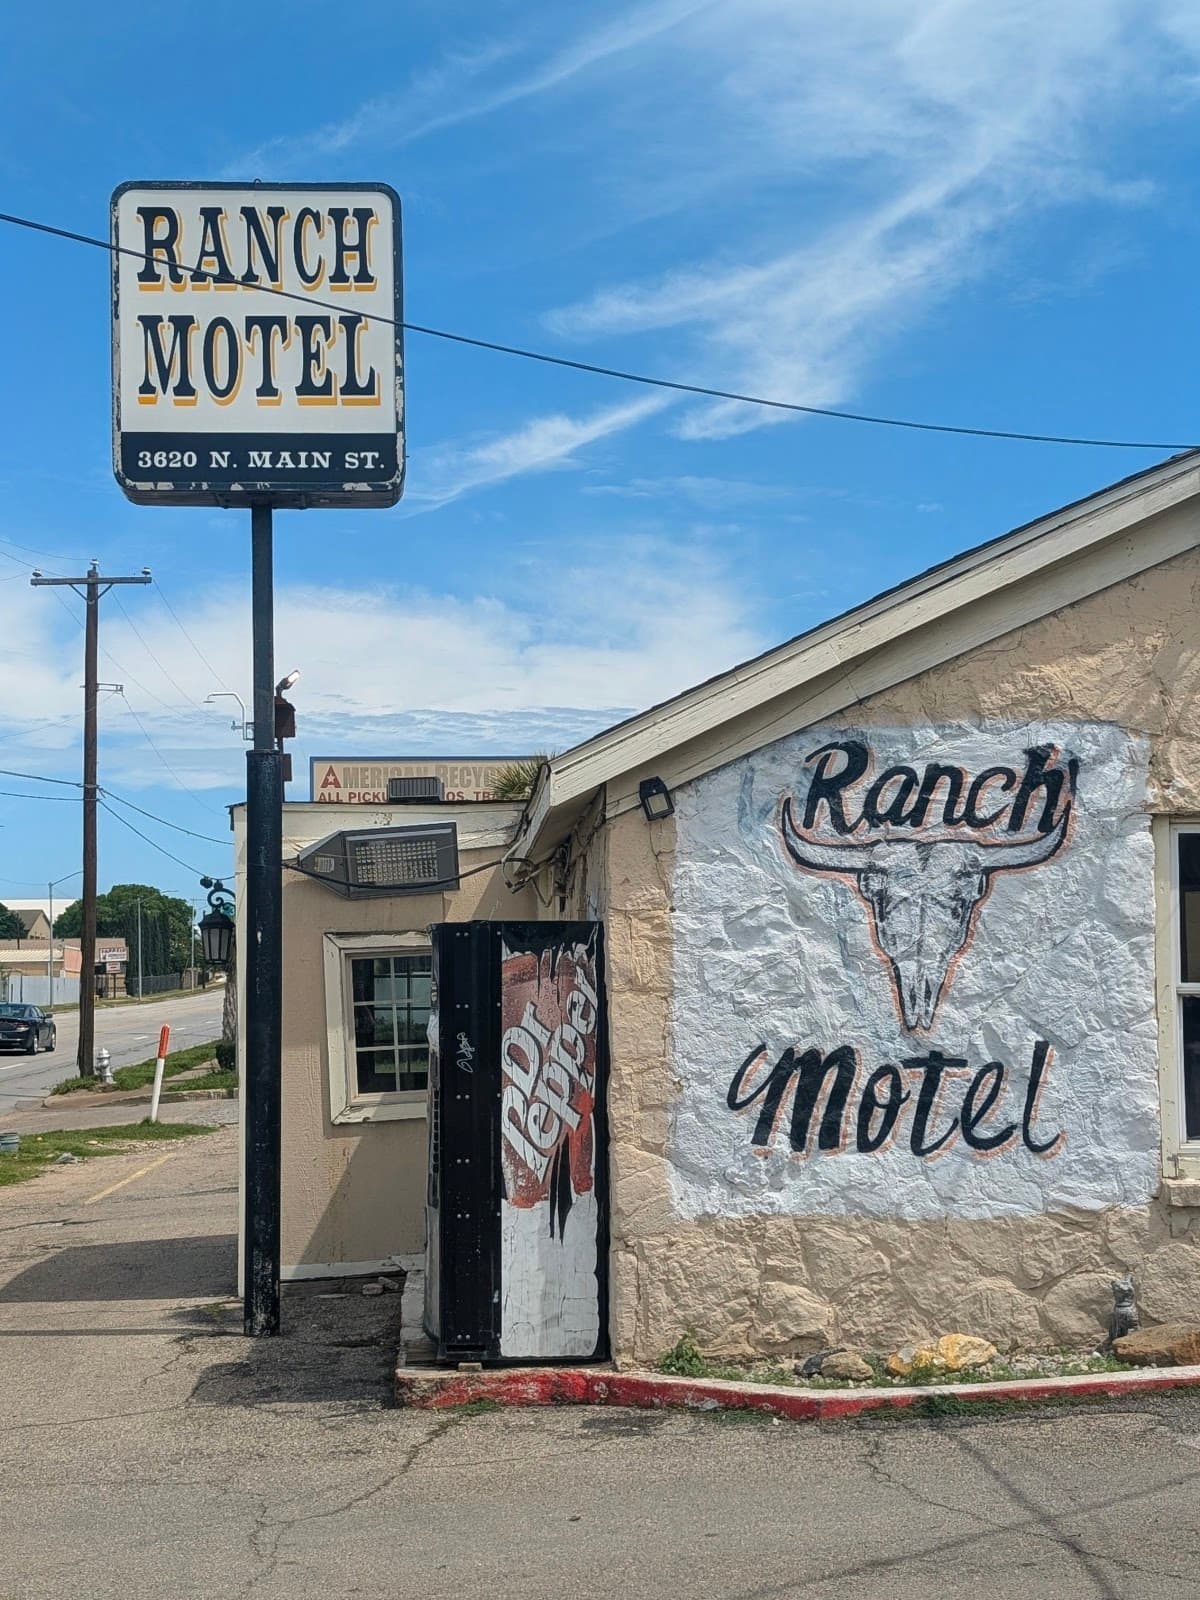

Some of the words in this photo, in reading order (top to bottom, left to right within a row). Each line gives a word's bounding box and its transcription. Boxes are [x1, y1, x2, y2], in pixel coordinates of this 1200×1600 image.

[136, 206, 378, 291] RANCH
[136, 315, 380, 406] MOTEL
[137, 451, 198, 469] 3620
[209, 451, 238, 469] N.
[248, 451, 332, 469] MAIN
[344, 452, 385, 469] ST.
[319, 791, 343, 802] ALL
[803, 740, 1078, 835] Ranch
